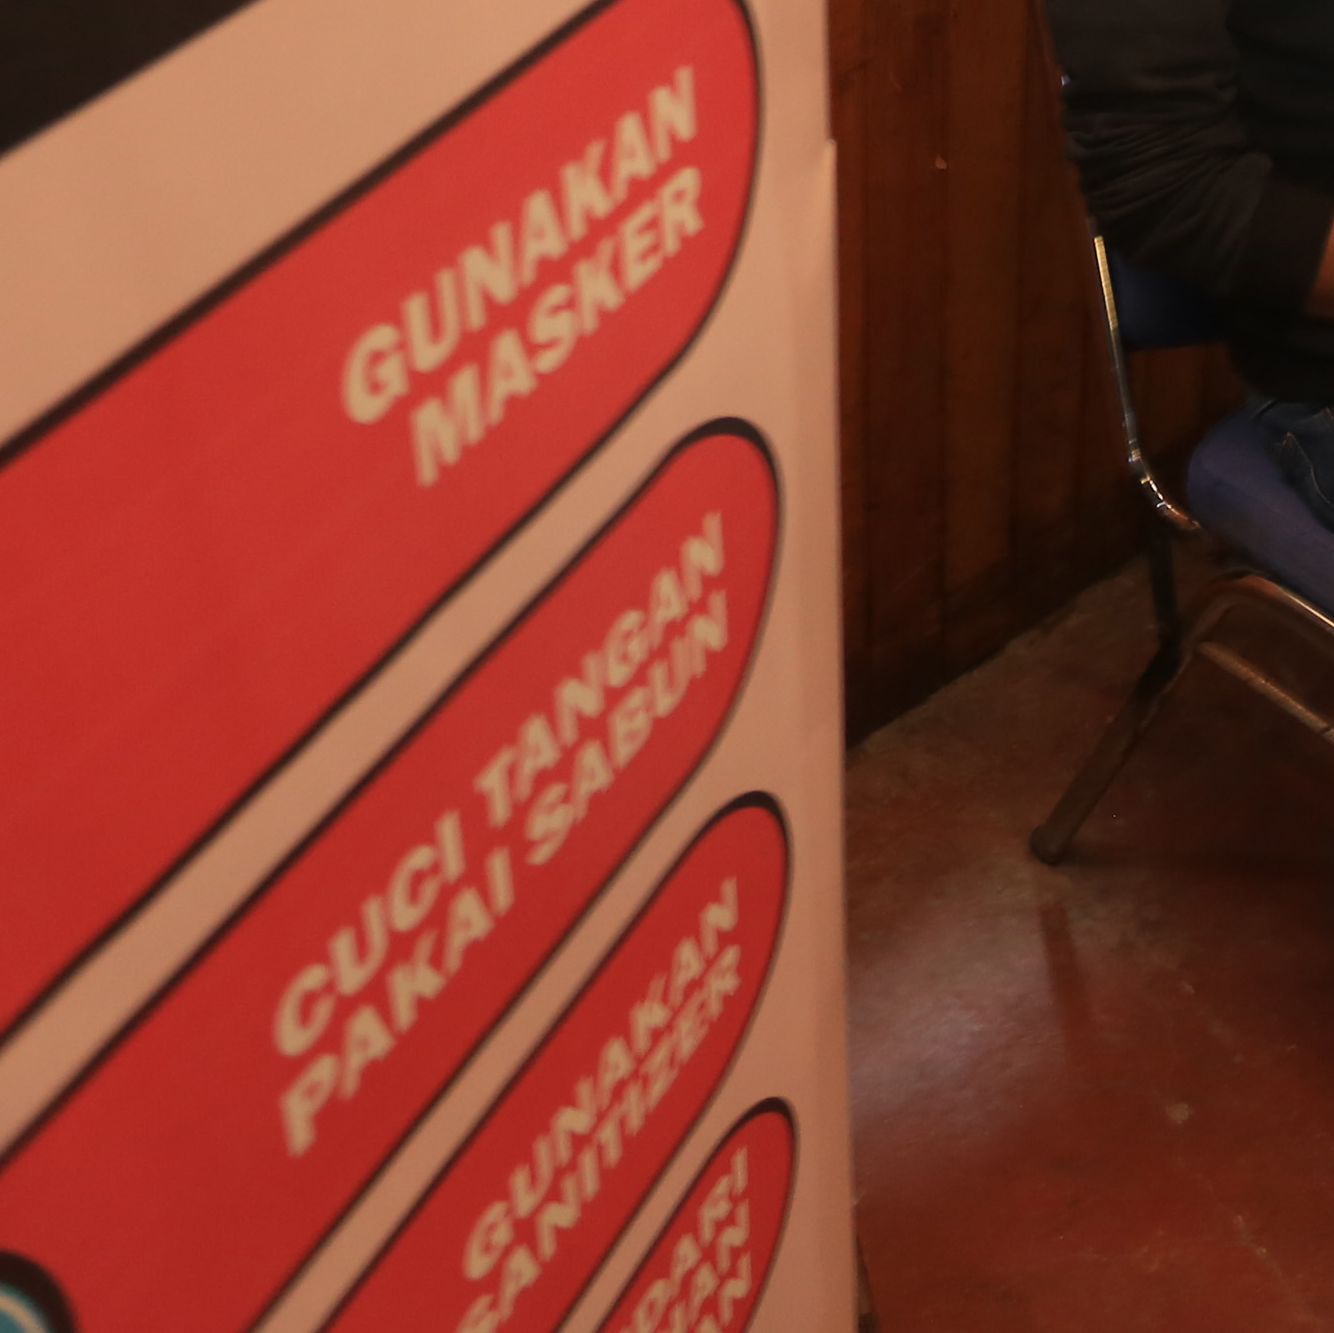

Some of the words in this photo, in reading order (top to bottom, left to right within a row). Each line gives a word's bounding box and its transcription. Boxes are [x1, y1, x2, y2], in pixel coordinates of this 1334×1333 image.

[341, 64, 697, 424] GUNAKAN
[410, 165, 705, 488] MASKER
[274, 809, 463, 1057] CUCI
[474, 510, 724, 828] TANGAN
[280, 846, 515, 1157] PAKAI
[526, 589, 727, 865] SABUN
[454, 943, 742, 1333] SANITIZER
[462, 876, 739, 1281] GUNAKAN
[627, 1146, 748, 1333] DARI
